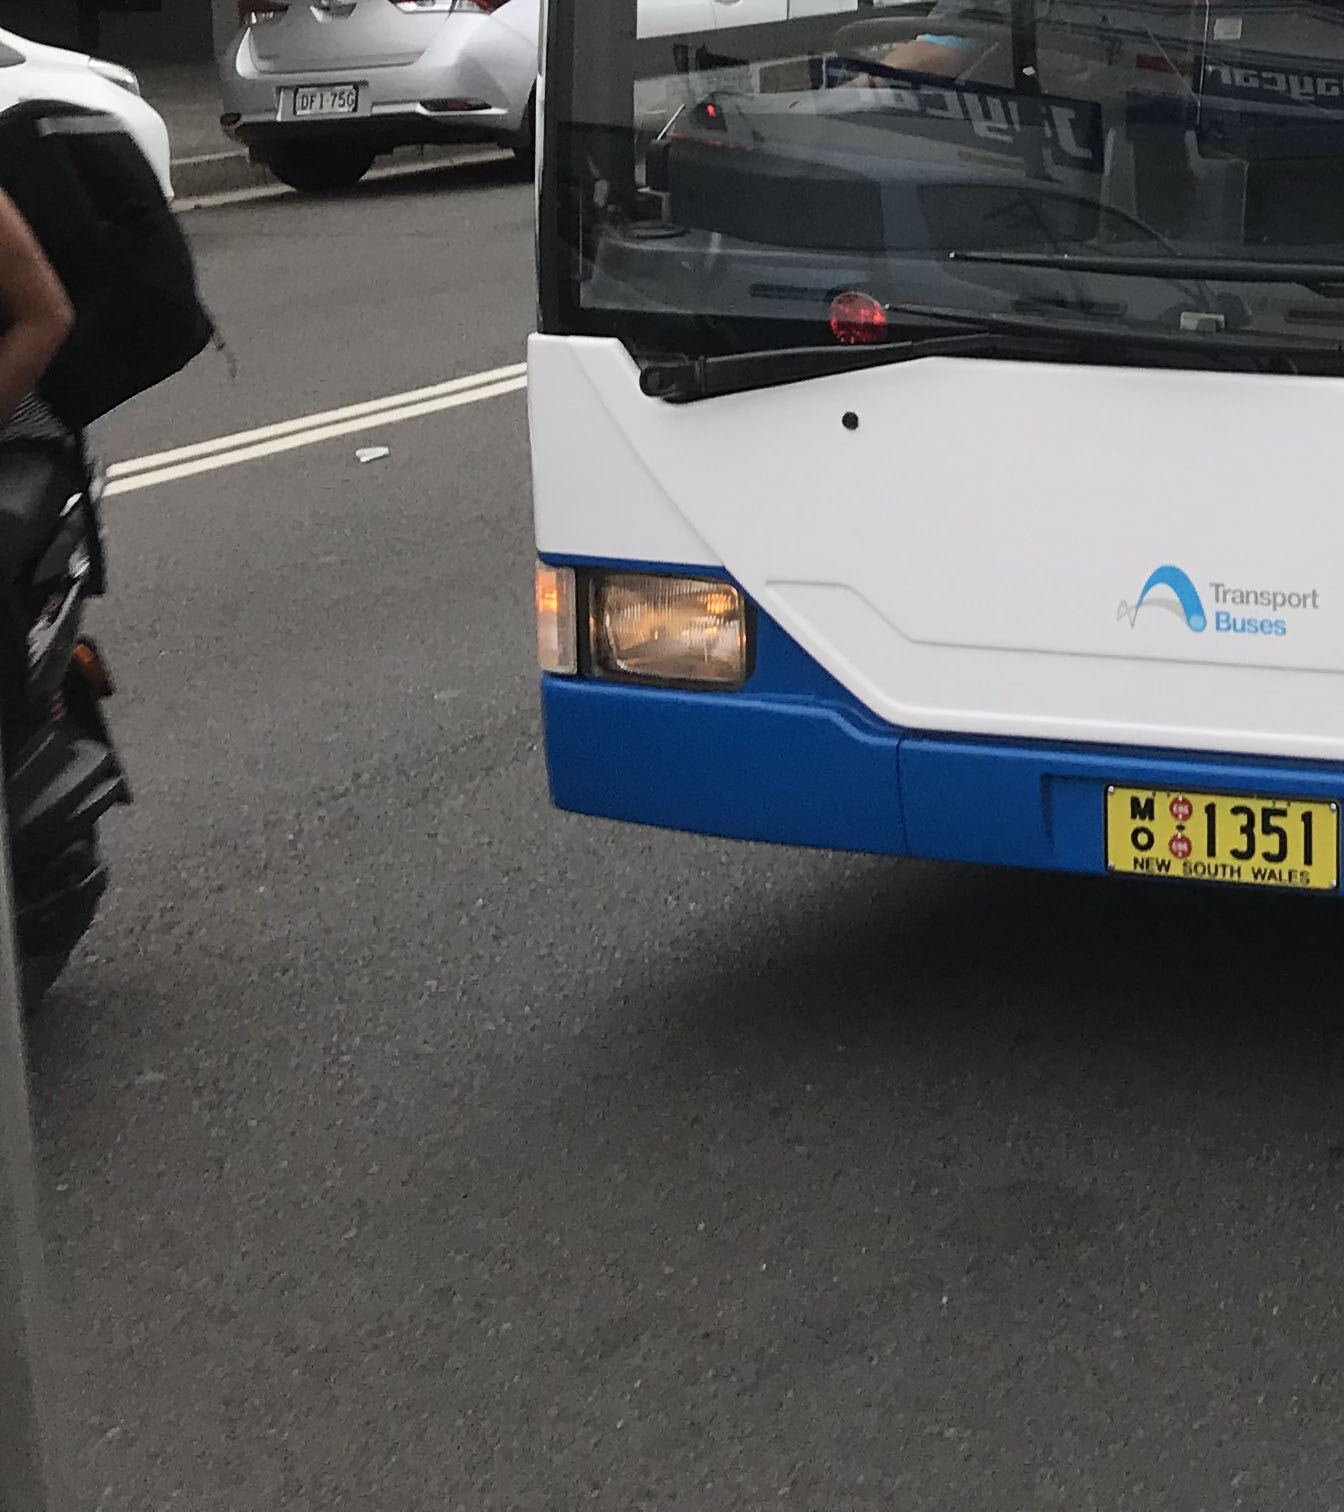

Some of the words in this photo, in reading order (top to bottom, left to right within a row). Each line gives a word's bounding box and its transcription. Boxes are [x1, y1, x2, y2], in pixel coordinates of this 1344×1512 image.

[1210, 582, 1320, 612] Transport
[1215, 611, 1287, 636] Buses
[1204, 802, 1314, 867] 1351
[1132, 856, 1172, 874] NEW
[1182, 860, 1242, 880] SOUTH
[1251, 866, 1311, 886] WALES
